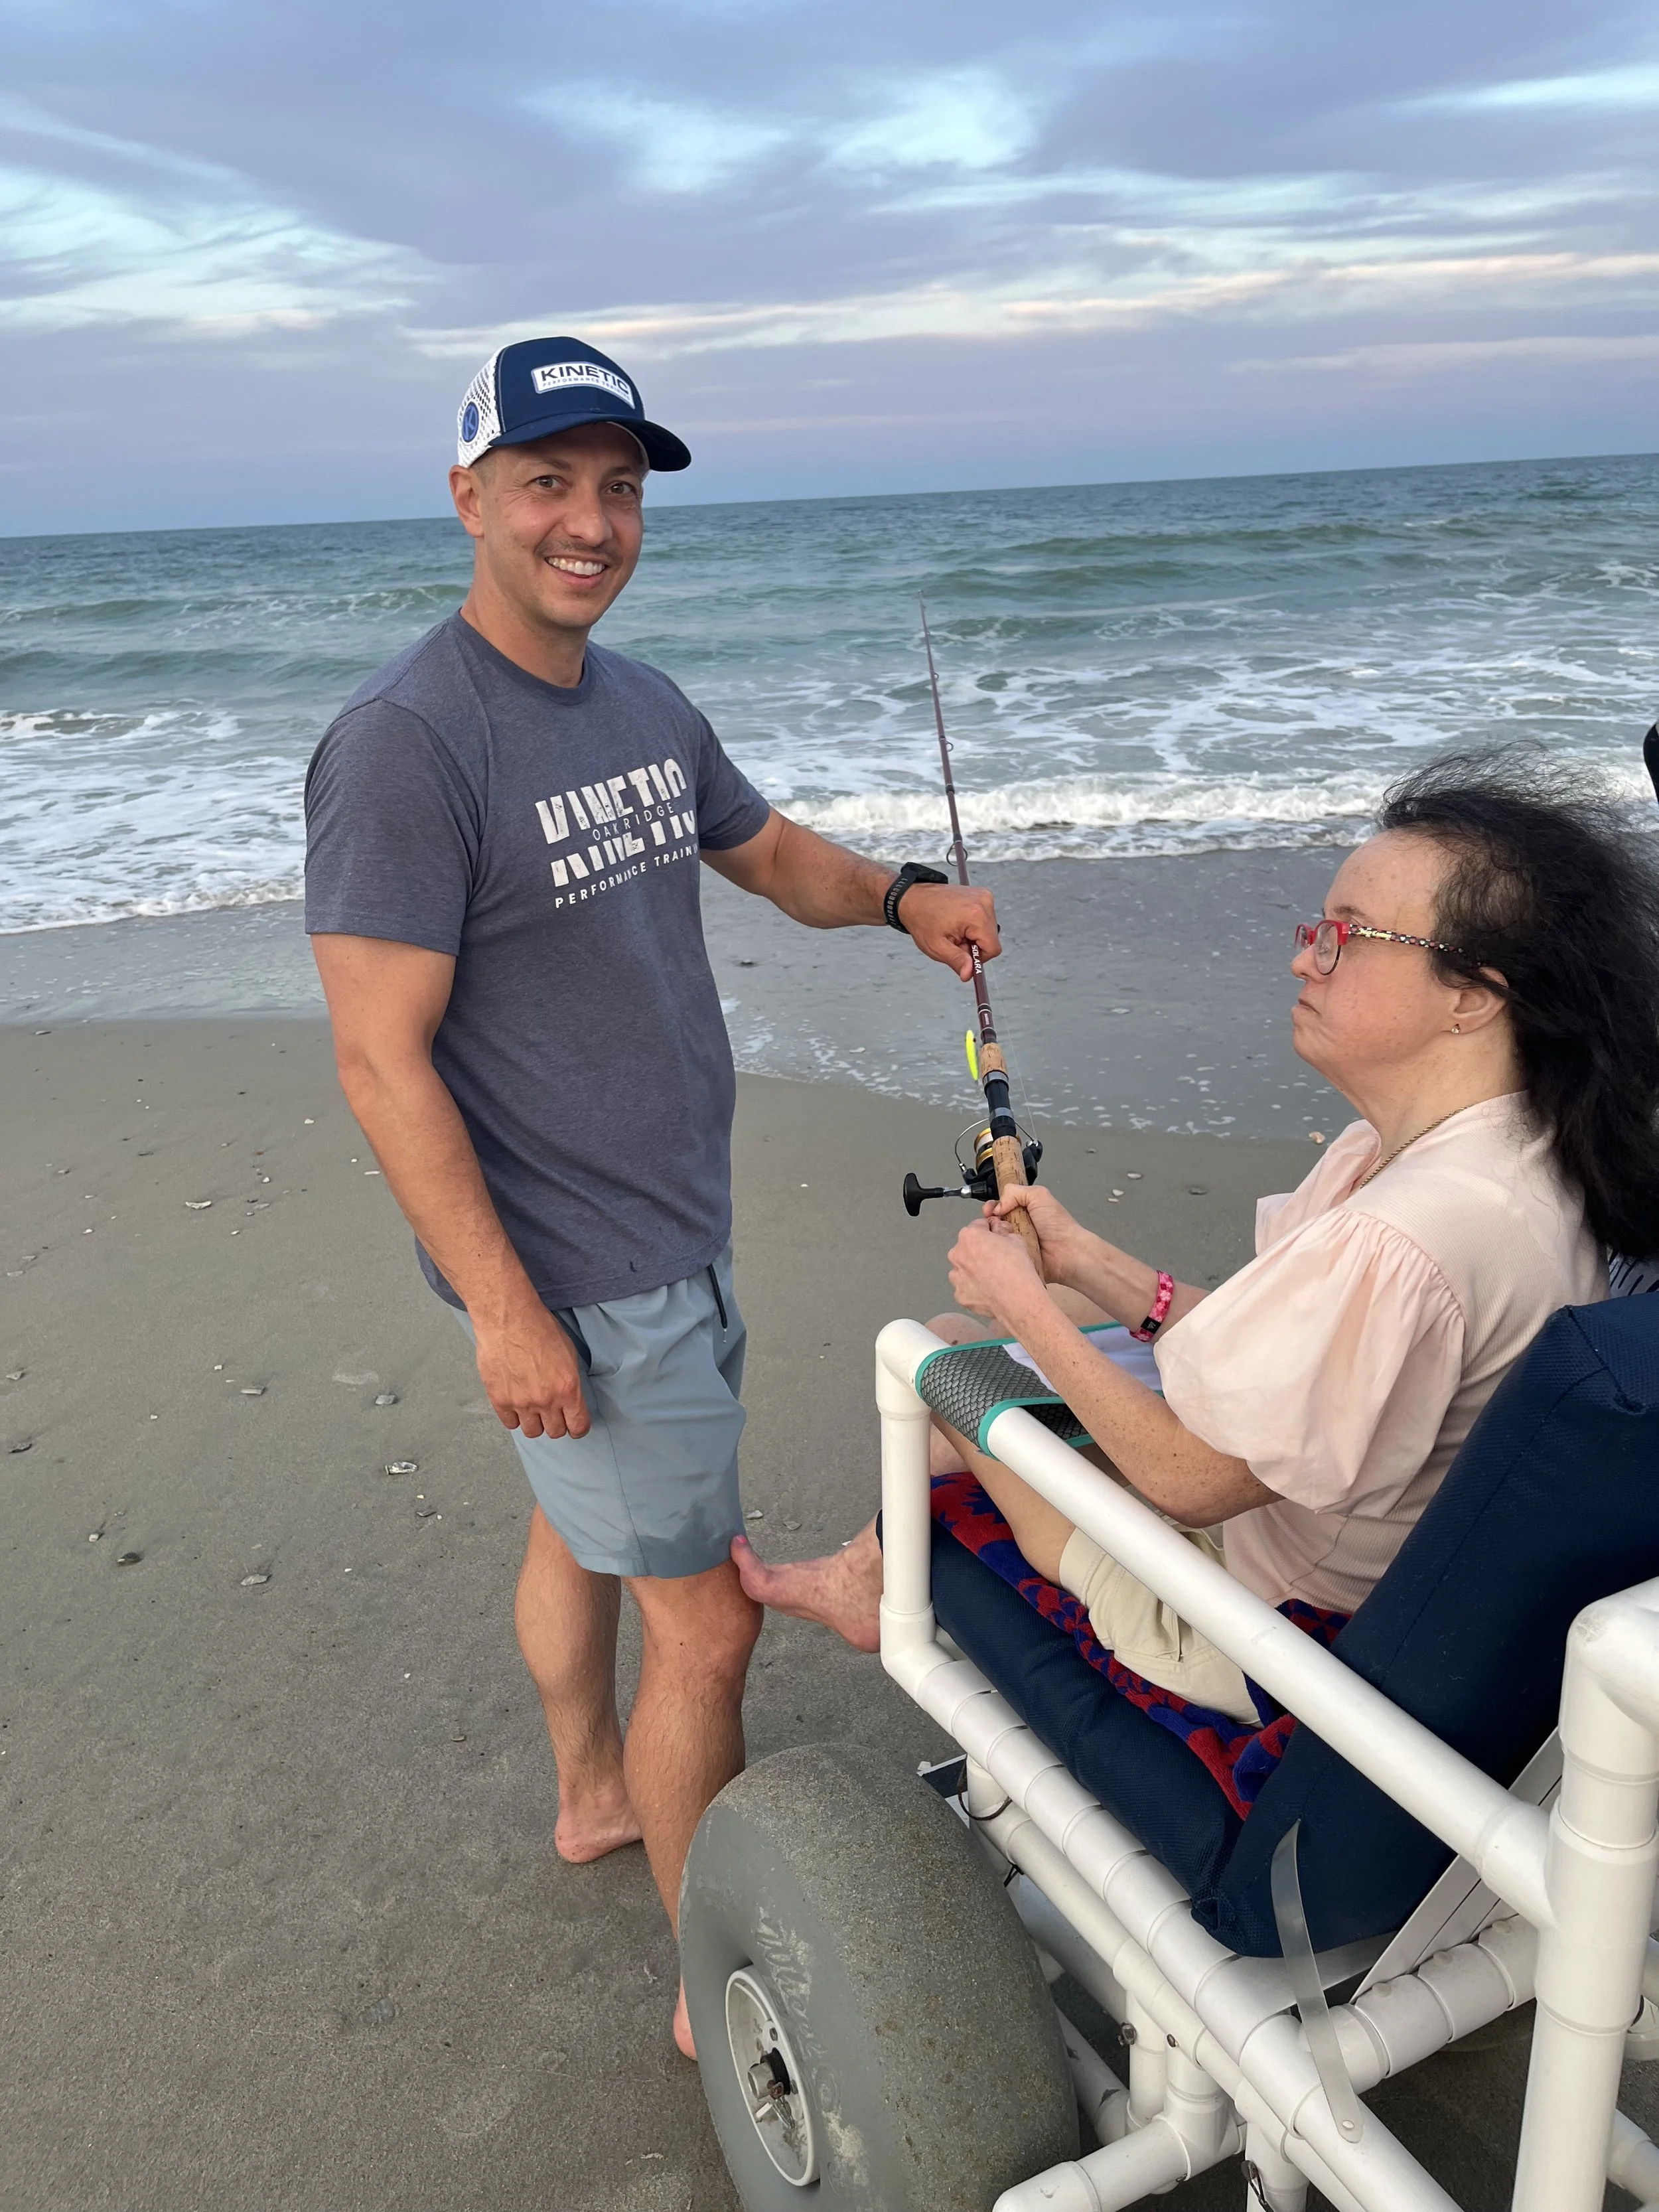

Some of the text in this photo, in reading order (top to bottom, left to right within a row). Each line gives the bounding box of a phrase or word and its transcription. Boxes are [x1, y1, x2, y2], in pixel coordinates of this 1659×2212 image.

[541, 365, 629, 395] KINETIC
[555, 861, 646, 908] PERFORMANCE
[972, 944, 982, 974] SOLARA
